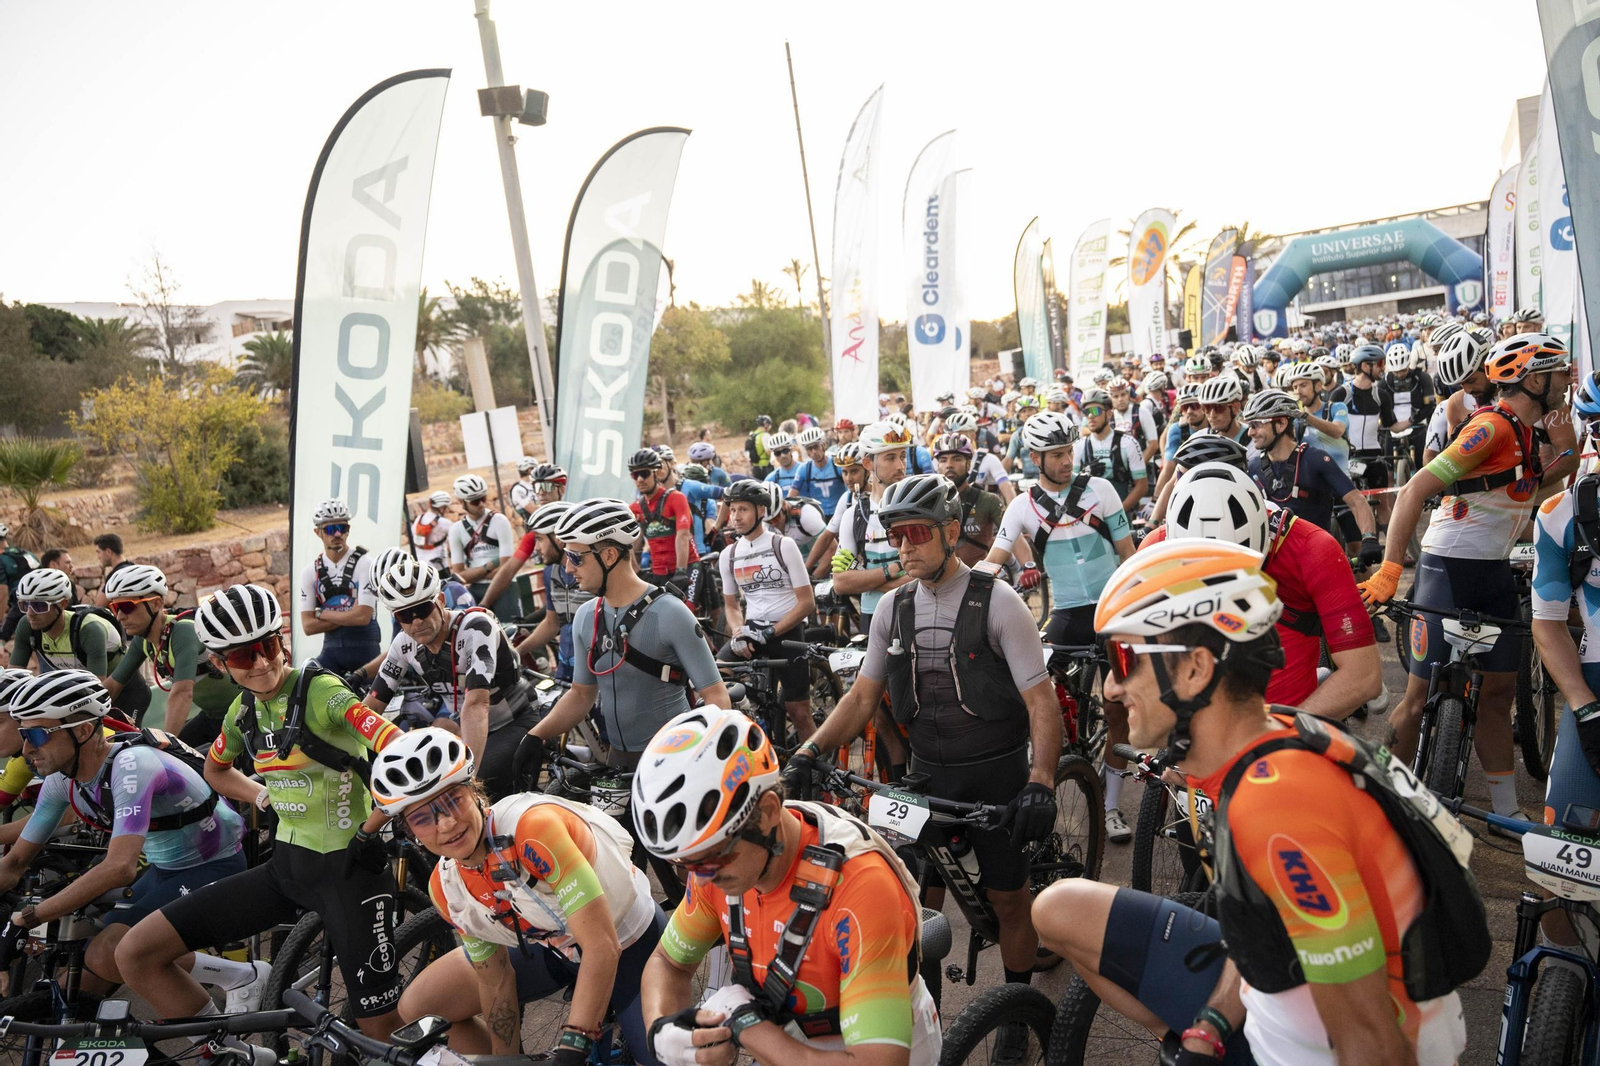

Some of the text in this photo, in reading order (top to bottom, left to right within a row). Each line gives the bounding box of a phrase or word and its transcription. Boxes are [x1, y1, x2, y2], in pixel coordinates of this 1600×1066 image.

[1311, 230, 1405, 256] UNIVERSAE
[1312, 252, 1345, 264] Instituto
[1346, 247, 1379, 260] Superior
[116, 805, 142, 819] EDF
[886, 802, 909, 820] 29
[1556, 844, 1593, 869] 49
[1540, 861, 1564, 874] JUAN
